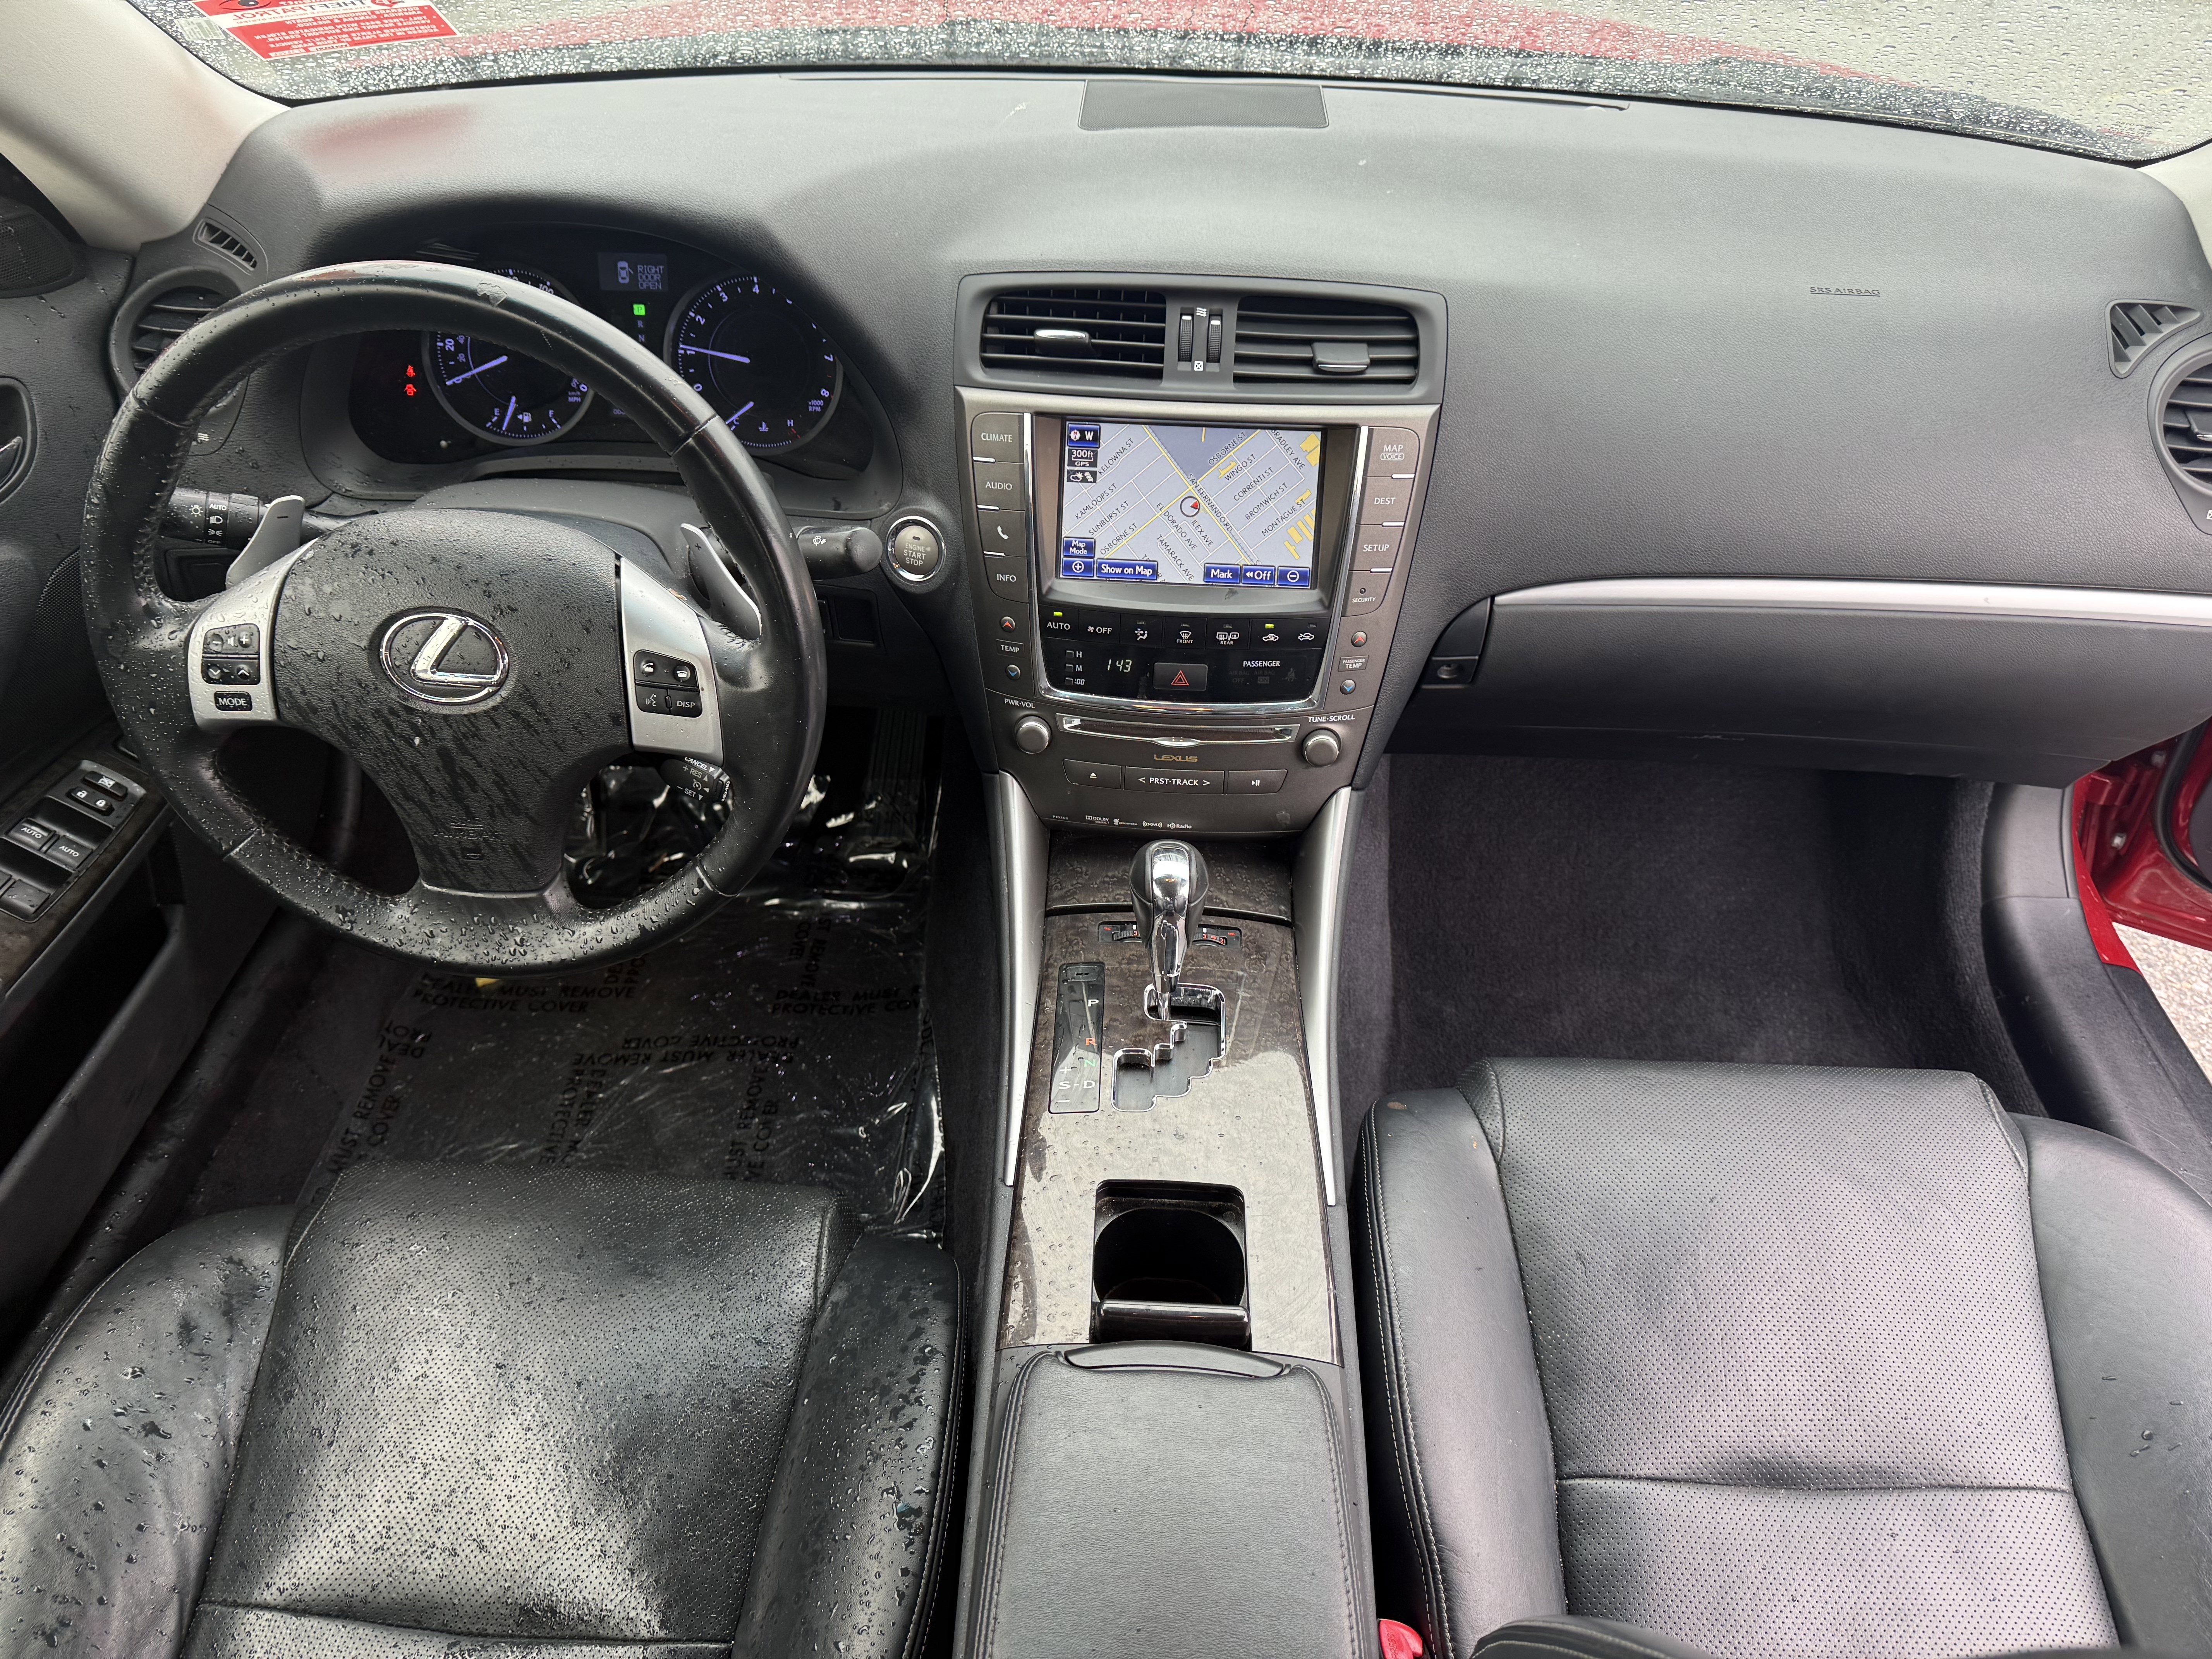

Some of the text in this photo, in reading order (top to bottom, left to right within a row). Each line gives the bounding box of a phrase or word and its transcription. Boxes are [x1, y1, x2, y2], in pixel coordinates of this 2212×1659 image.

[637, 265, 664, 274] RIGHT
[638, 273, 661, 282] DOOR
[752, 285, 759, 294] 4
[720, 292, 728, 301] 3
[695, 315, 705, 325] 2
[445, 338, 455, 351] 20
[821, 389, 829, 397] 8
[981, 433, 1012, 442] CLIMATE
[1085, 431, 1094, 441] W
[1208, 431, 1247, 465] OSBORNE ST
[1271, 430, 1305, 470] BRADLEY AVE
[1072, 450, 1093, 458] 300ft
[1098, 438, 1134, 476] KELOWNA ST
[1224, 453, 1256, 481] WINGO ST
[986, 481, 1012, 490] AUDIO
[1234, 467, 1274, 501] CORRENTI ST
[1075, 483, 1117, 520] KAMLOOPS ST
[1187, 474, 1233, 532] SAN FERNANDO RD
[1245, 483, 1288, 520] BROMWICH ST
[1089, 500, 1129, 536] SUNBURST ST
[1261, 498, 1306, 536] MONTAGUE ST
[1156, 502, 1198, 551] EL DORADO AVE
[1191, 519, 1214, 547] ILEX AVE
[1100, 522, 1138, 555] OSBORNE ST
[905, 543, 925, 552] ENGINE
[1072, 540, 1086, 548] Map
[904, 550, 926, 560] START
[1157, 534, 1185, 569] TAMARACK
[1182, 568, 1194, 582] AVE
[906, 558, 923, 567] STOP
[1101, 564, 1122, 574] Show
[1135, 565, 1152, 577] Map
[1211, 568, 1232, 579] Mark
[1254, 571, 1271, 580] Off
[997, 574, 1017, 582] INFO
[1047, 622, 1070, 630] AUTO
[218, 698, 247, 706] MODE
[677, 700, 695, 708] DISP
[684, 757, 708, 770] CANCEL
[690, 768, 702, 778] RES
[684, 788, 696, 797] SET
[21, 827, 42, 839] AUTO
[58, 845, 79, 857] AUTO
[560, 985, 637, 999] REMOVE
[527, 999, 589, 1012] COVER
[1085, 1038, 1097, 1046] R
[572, 1050, 714, 1066] MUST REMOVE
[1084, 1059, 1096, 1067] N
[352, 1054, 397, 1120] REMOVE
[1058, 1080, 1096, 1089] S D
